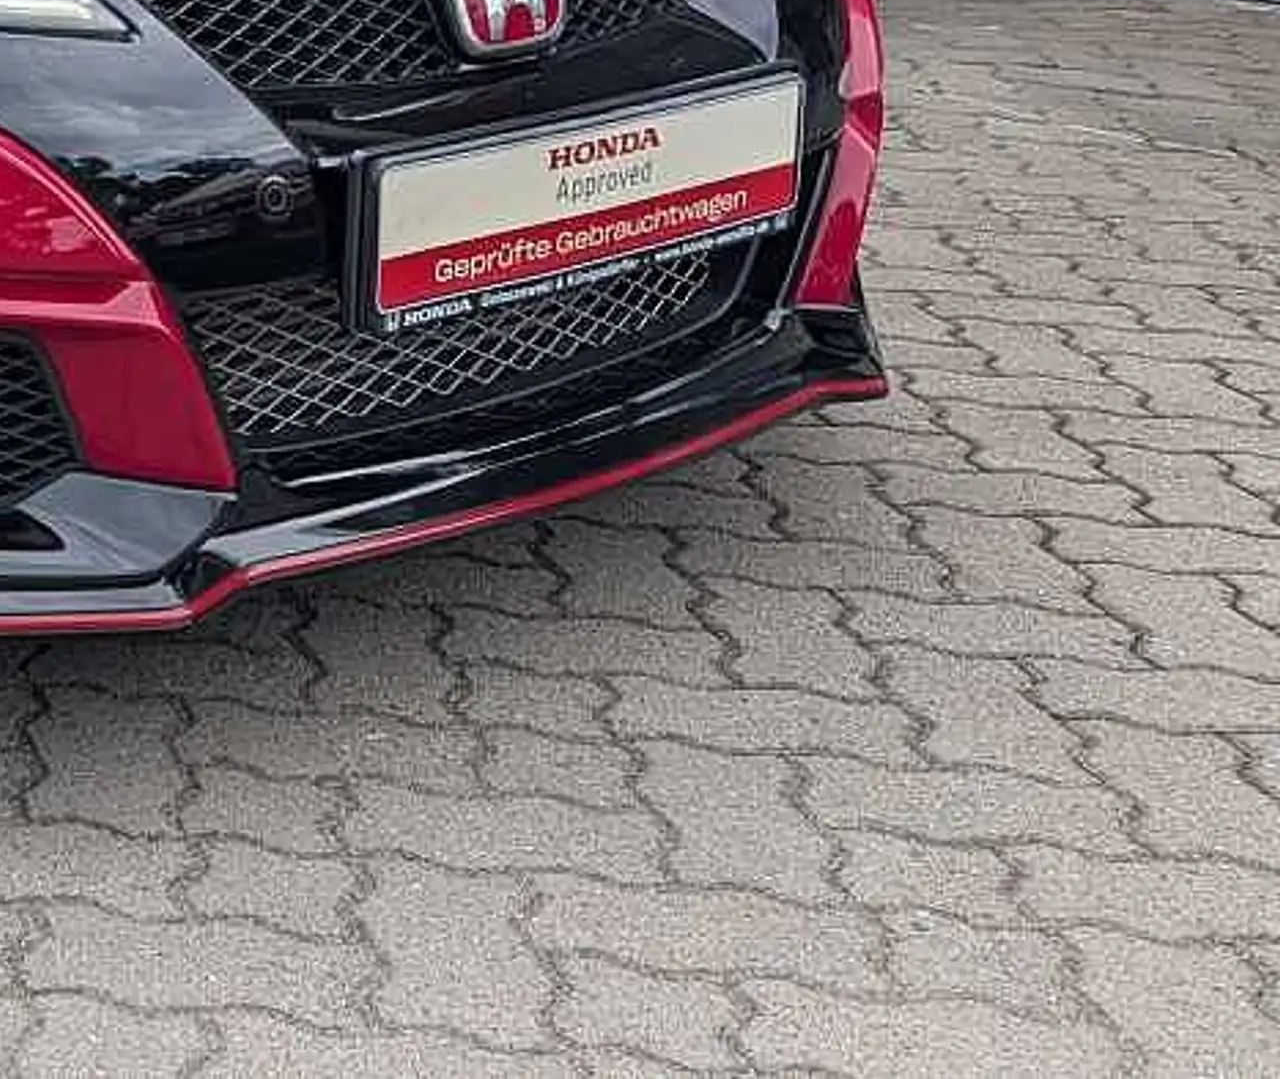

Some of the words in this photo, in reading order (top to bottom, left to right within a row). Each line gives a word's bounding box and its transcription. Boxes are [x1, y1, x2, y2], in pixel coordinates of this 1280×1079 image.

[548, 126, 661, 171] HONDA
[555, 161, 653, 205] Approved
[434, 236, 553, 284] Geprüfte
[555, 189, 748, 254] Gebrauchtwagen
[402, 297, 473, 327] HONDA
